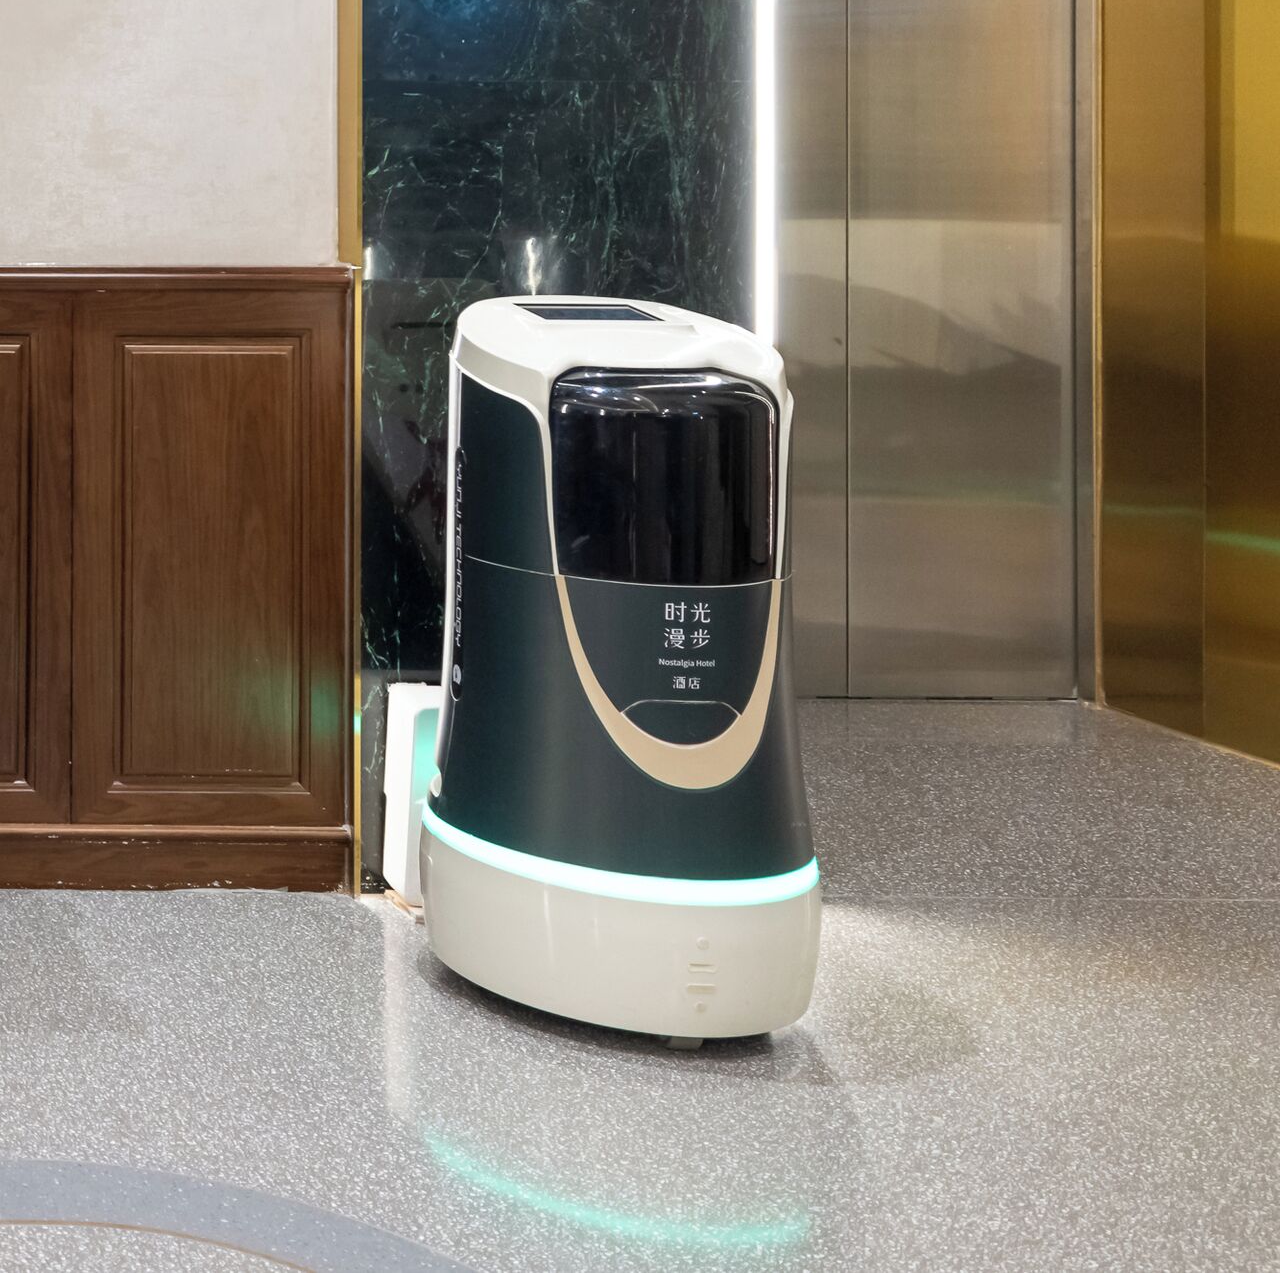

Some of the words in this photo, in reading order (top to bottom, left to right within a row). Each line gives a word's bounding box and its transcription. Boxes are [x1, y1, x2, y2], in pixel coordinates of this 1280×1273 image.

[454, 523, 464, 648] TECHNOLOGY
[664, 601, 711, 624] 时光
[663, 628, 711, 650] 漫步
[658, 658, 695, 669] Nostalgia
[696, 659, 716, 668] Hotel
[672, 675, 701, 690] 酒店
